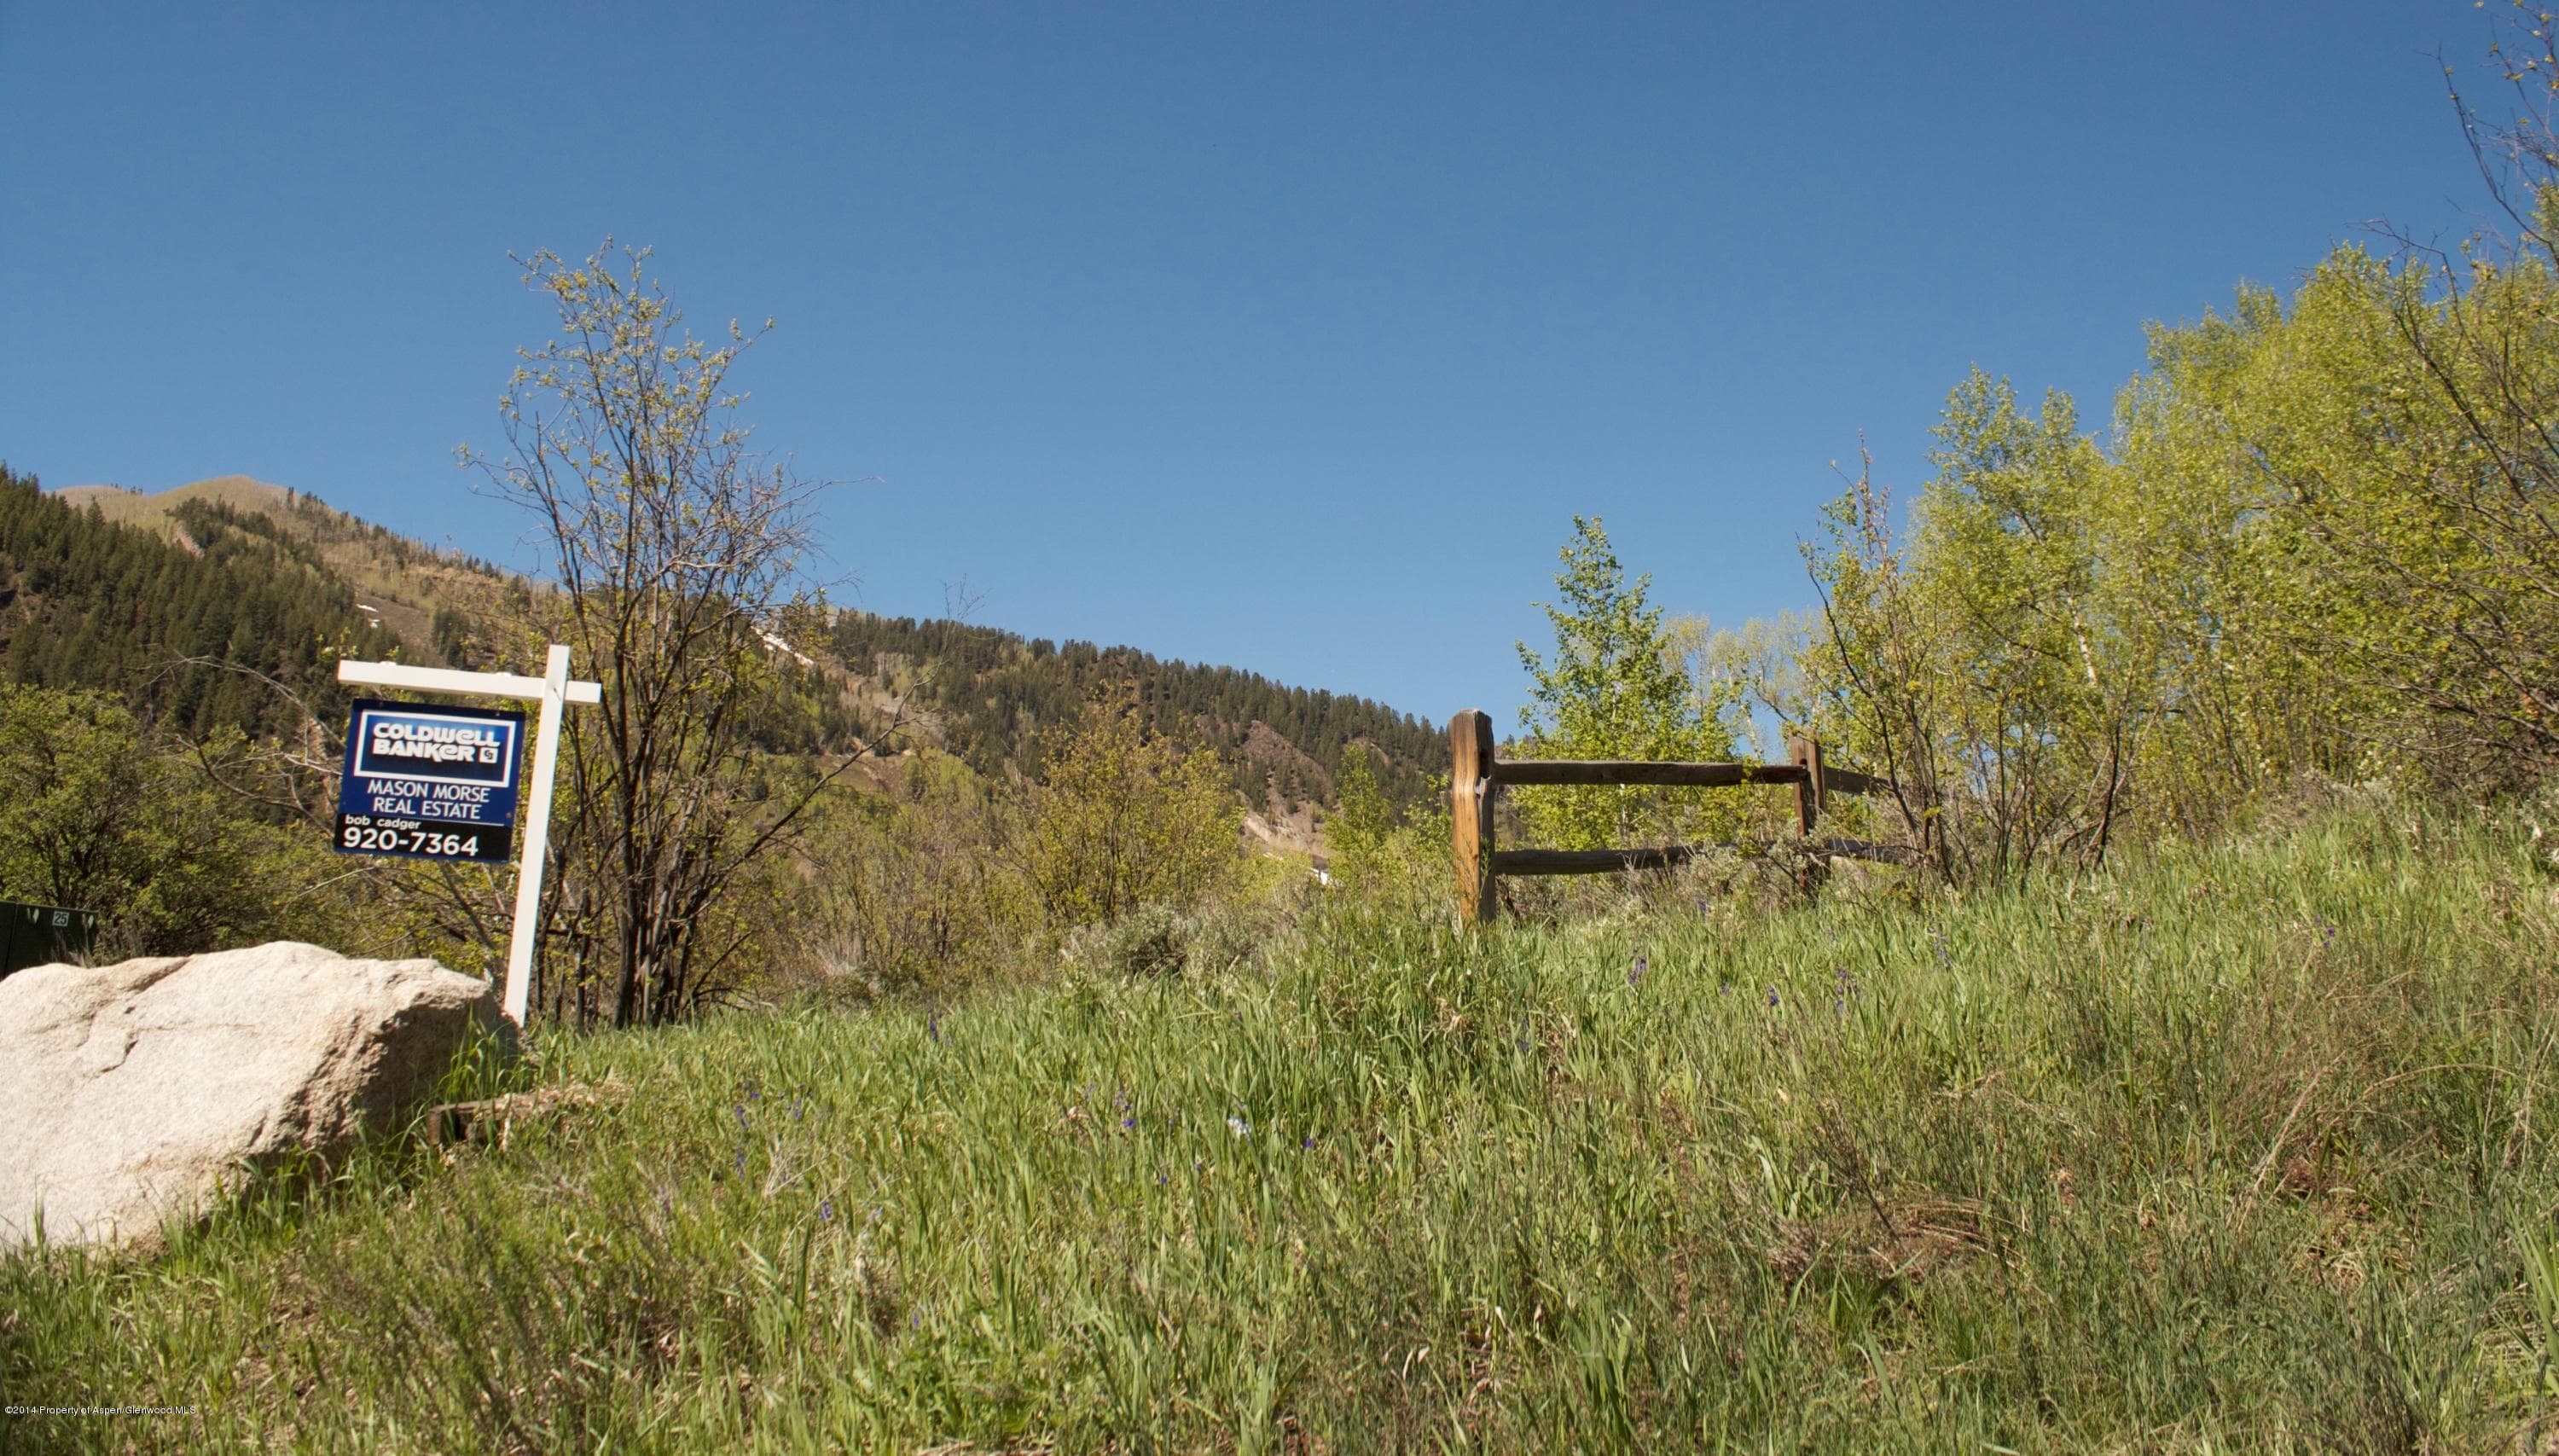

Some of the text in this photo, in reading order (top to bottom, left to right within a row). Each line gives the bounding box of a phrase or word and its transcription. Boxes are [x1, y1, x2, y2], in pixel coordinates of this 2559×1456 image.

[367, 780, 491, 803] MASON MORSE
[373, 797, 482, 820] REAL ESTATE
[345, 815, 421, 830] bob cadger
[344, 827, 479, 856] 920-7364
[55, 913, 67, 925] 25
